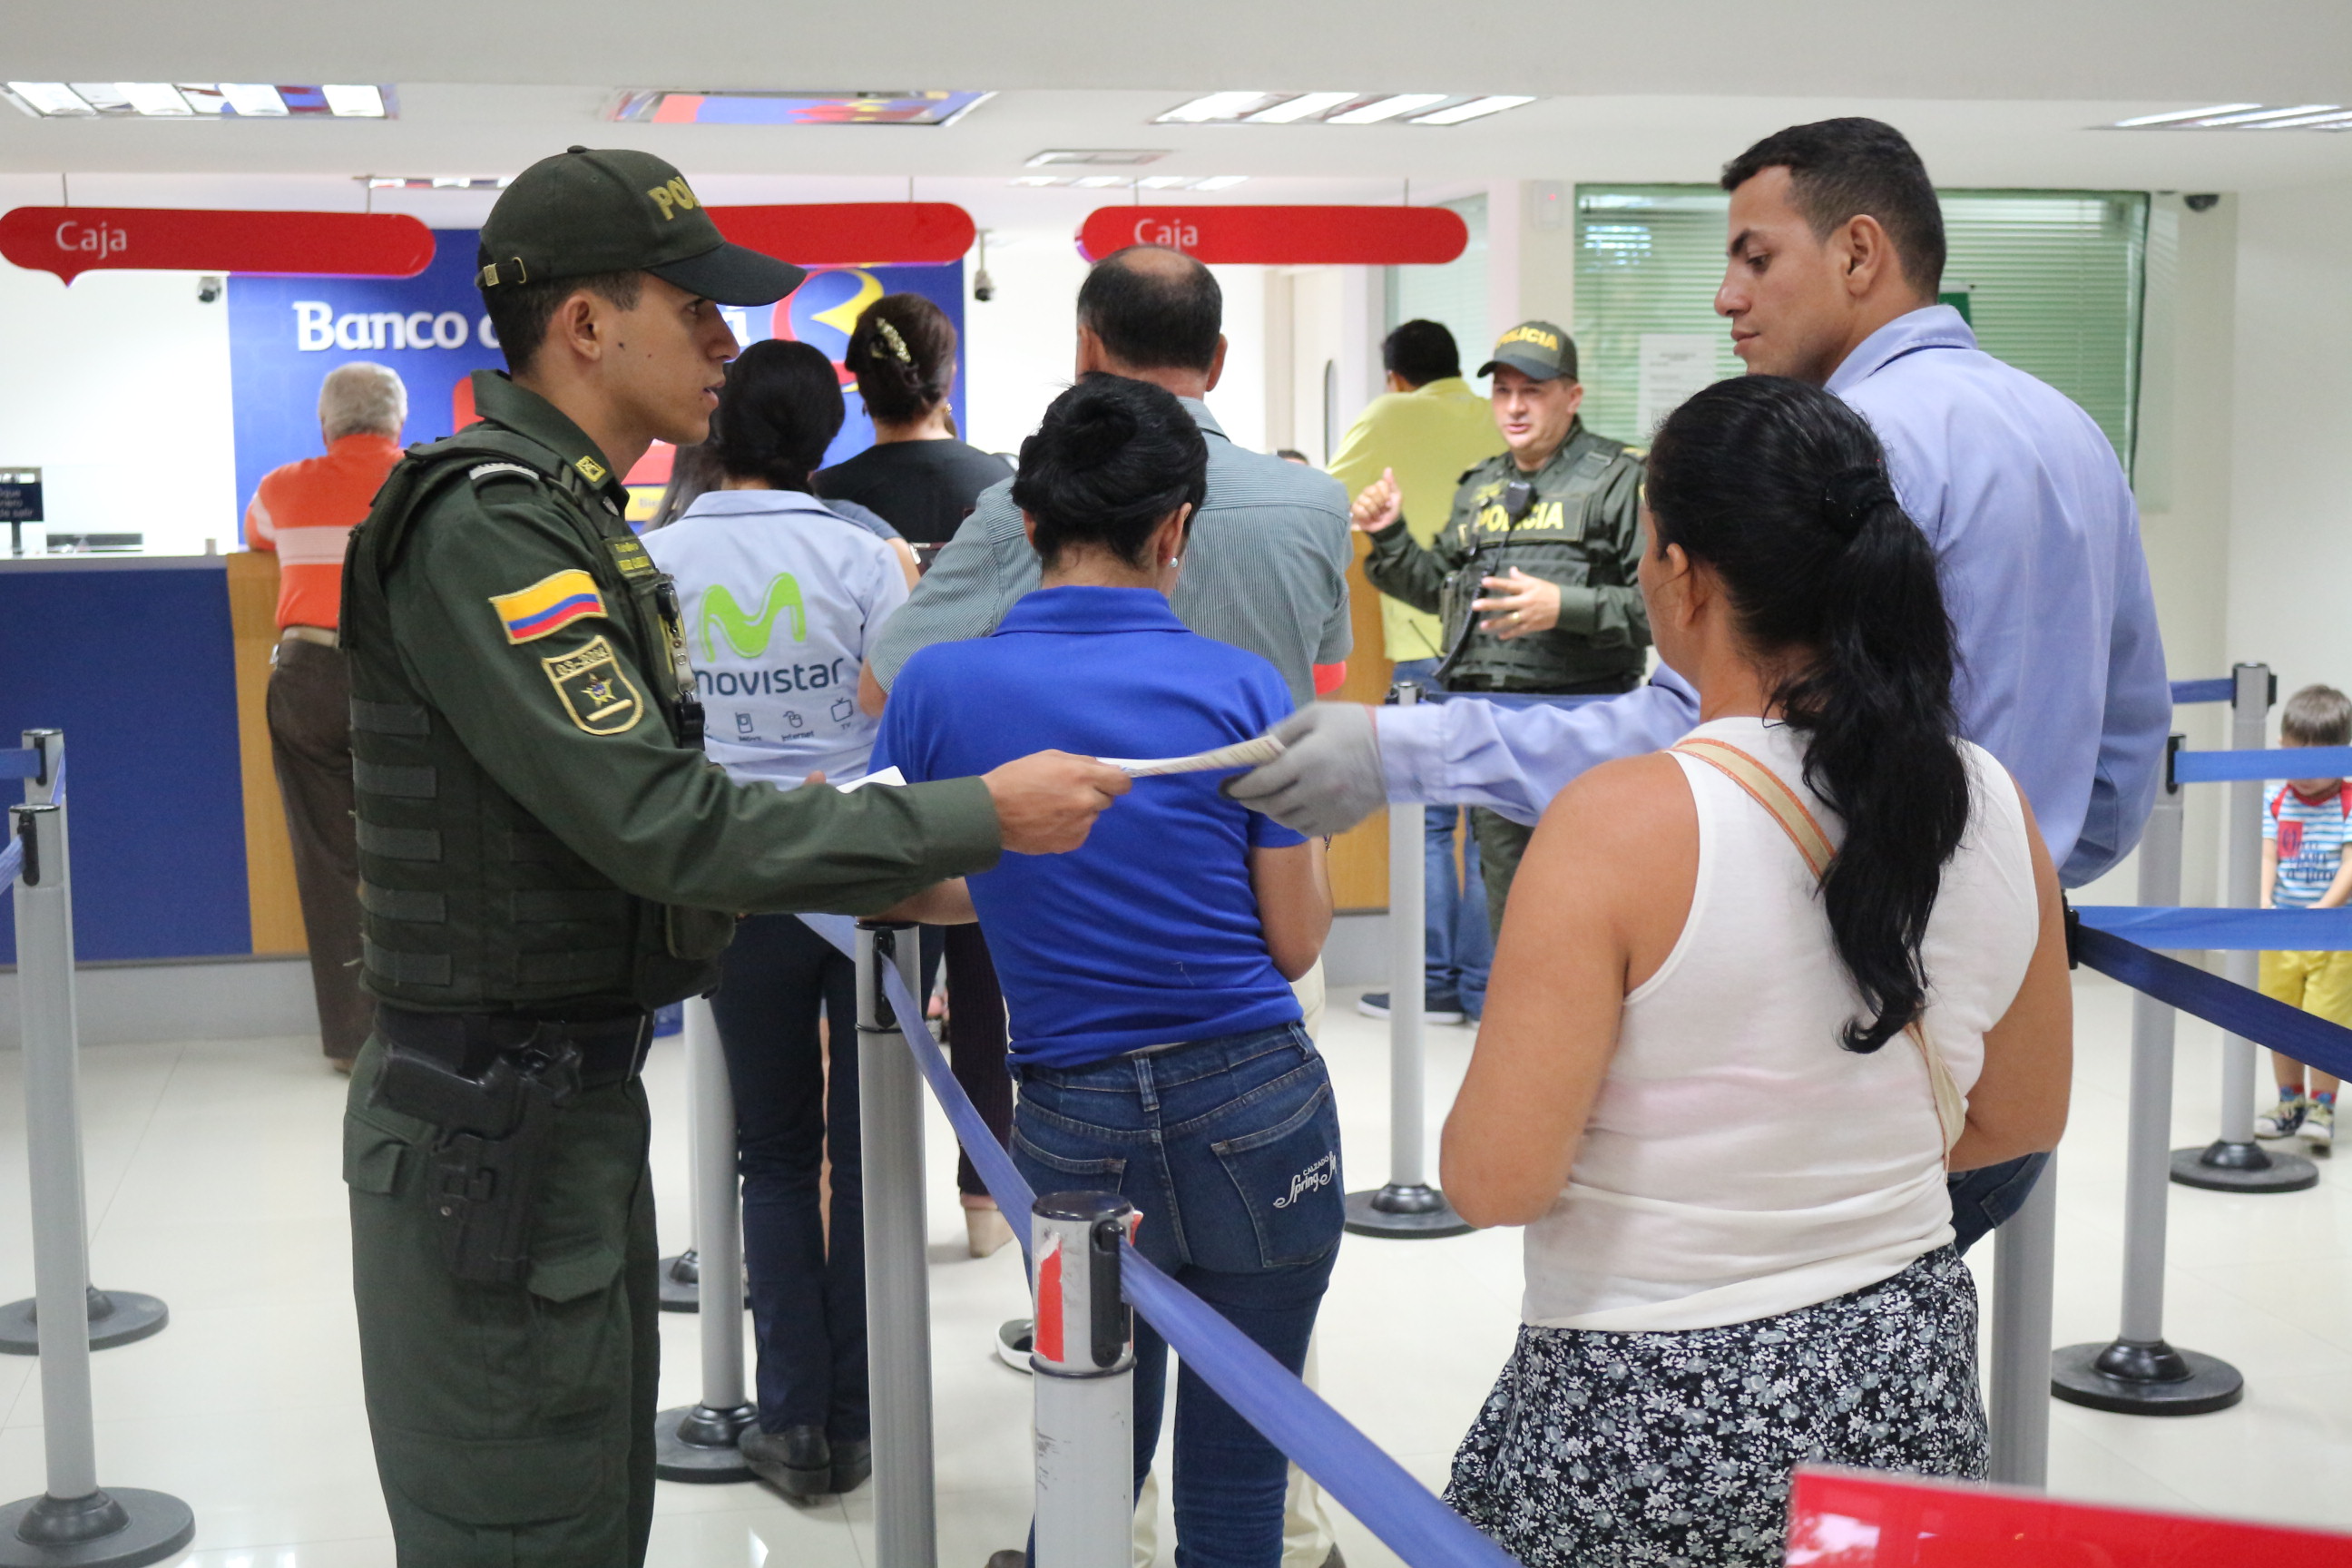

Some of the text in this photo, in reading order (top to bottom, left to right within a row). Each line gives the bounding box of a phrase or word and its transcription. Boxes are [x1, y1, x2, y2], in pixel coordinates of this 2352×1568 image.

[55, 220, 127, 260] Caja
[1134, 218, 1199, 251] Caja
[291, 300, 469, 352] Banco
[1302, 1155, 1329, 1176] CALZADO
[1272, 1172, 1320, 1209] Spring
